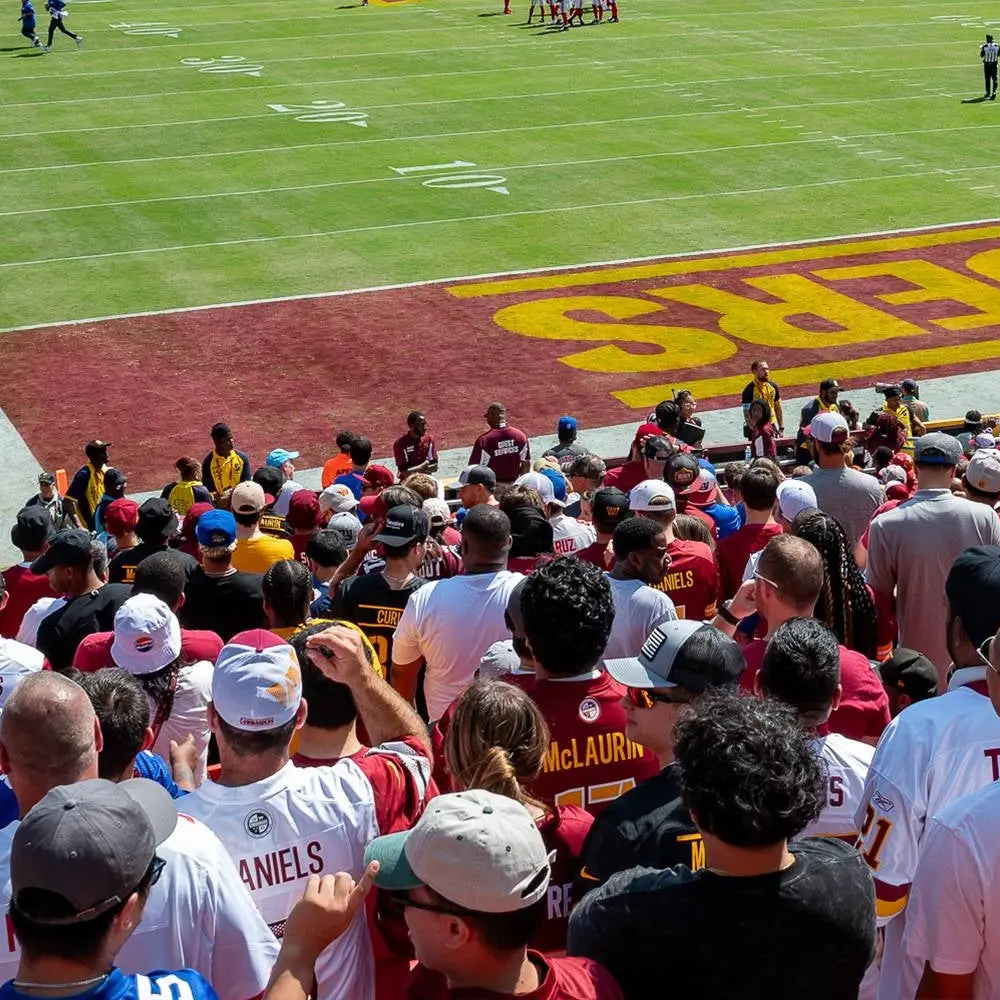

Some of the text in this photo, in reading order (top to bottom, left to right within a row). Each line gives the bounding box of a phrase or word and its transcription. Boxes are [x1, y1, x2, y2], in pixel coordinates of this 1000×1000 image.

[266, 100, 369, 122] 20
[389, 160, 509, 189] 10
[498, 439, 515, 448] GUEST
[260, 517, 281, 530] AURIN
[554, 538, 576, 553] RUZ
[655, 571, 694, 592] ANIELS
[544, 731, 644, 773] McLAURIN
[238, 840, 324, 892] ANIELS
